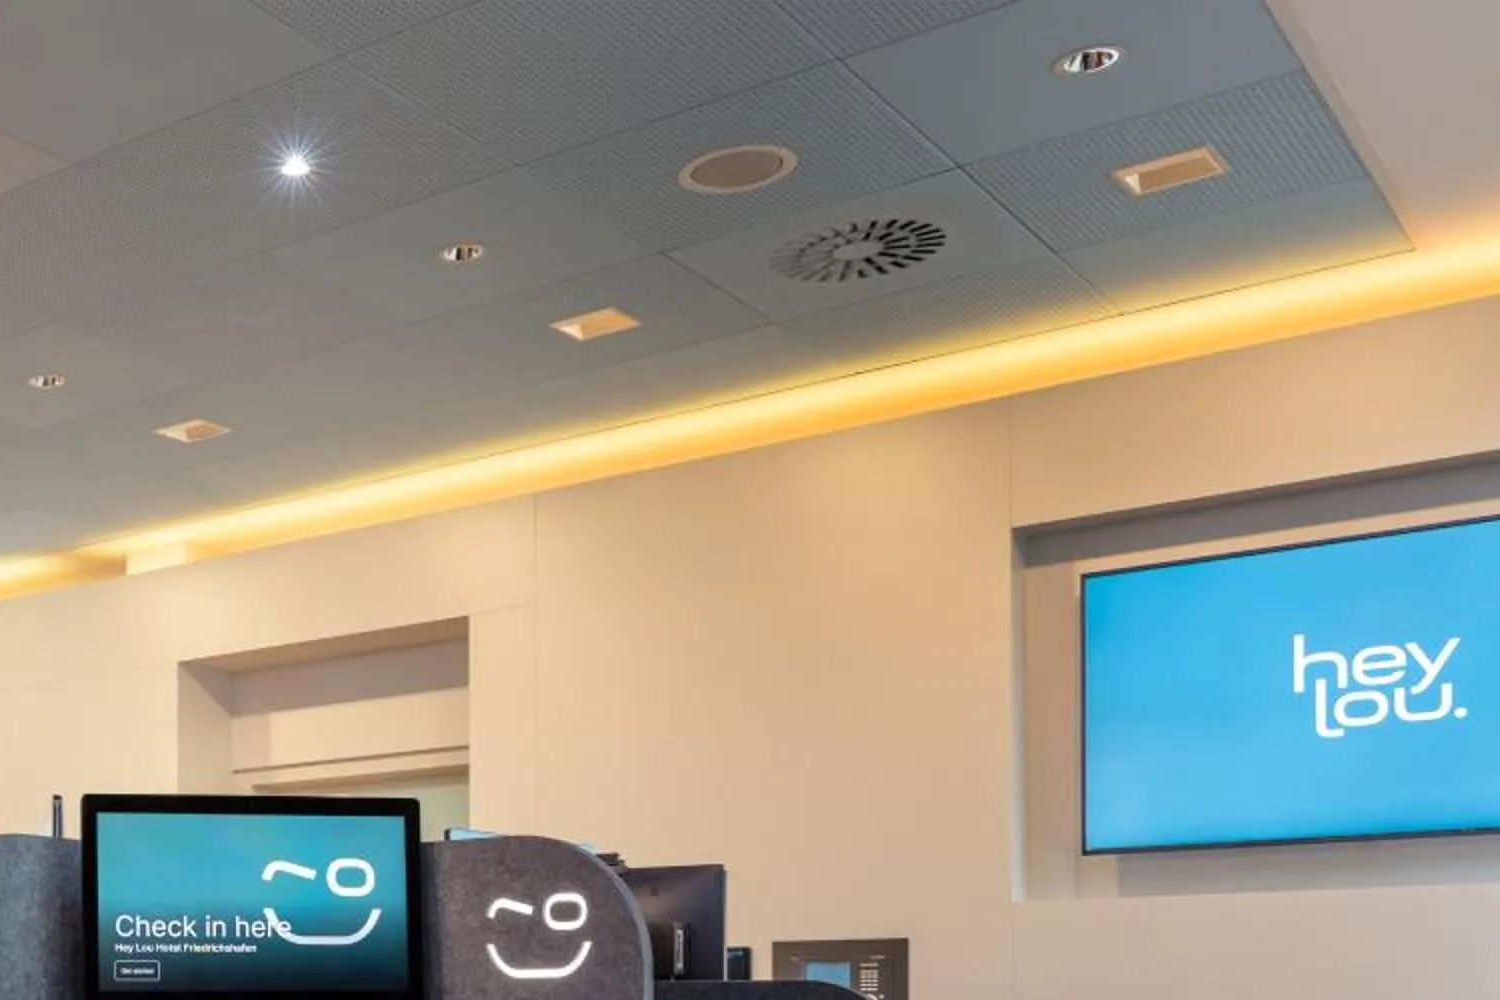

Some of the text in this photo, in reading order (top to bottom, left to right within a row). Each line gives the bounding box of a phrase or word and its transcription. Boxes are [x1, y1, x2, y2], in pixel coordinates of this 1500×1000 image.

[1293, 633, 1461, 695] hey
[1314, 678, 1469, 738] lou.
[115, 914, 292, 938] Check in here
[114, 943, 257, 954] Hey Lou Hotel Friedrichshafen
